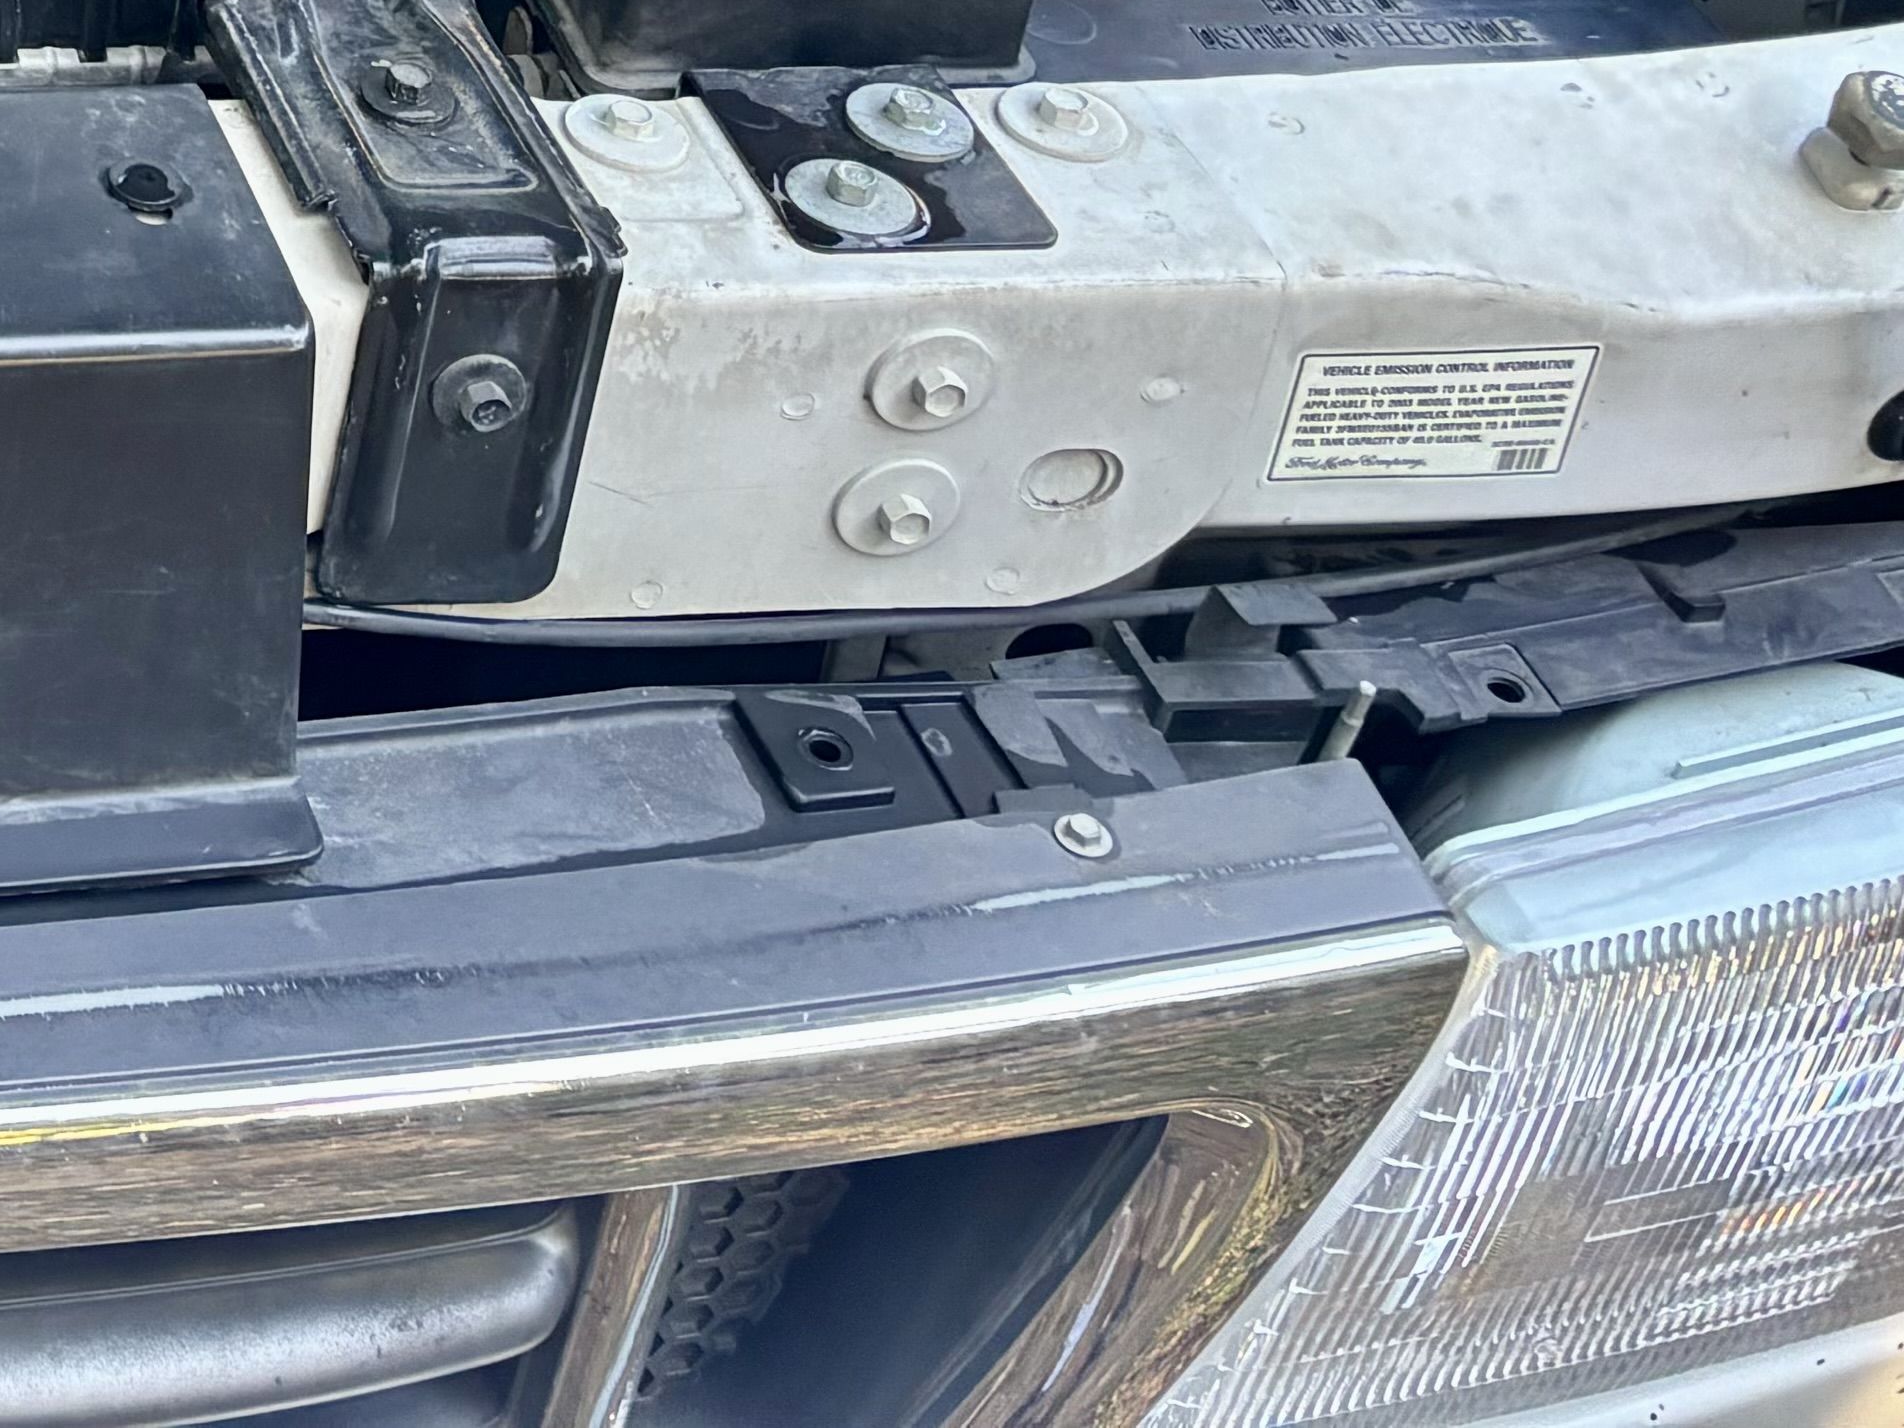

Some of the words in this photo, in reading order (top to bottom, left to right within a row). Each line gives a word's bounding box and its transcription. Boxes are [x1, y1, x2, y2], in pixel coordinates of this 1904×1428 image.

[1188, 22, 1373, 50] DISTRIBUTION
[1322, 366, 1372, 377] VEHICLE
[1374, 364, 1433, 376] EMISSION
[1435, 362, 1489, 373] CONTROL
[1492, 359, 1575, 372] INFORMATION
